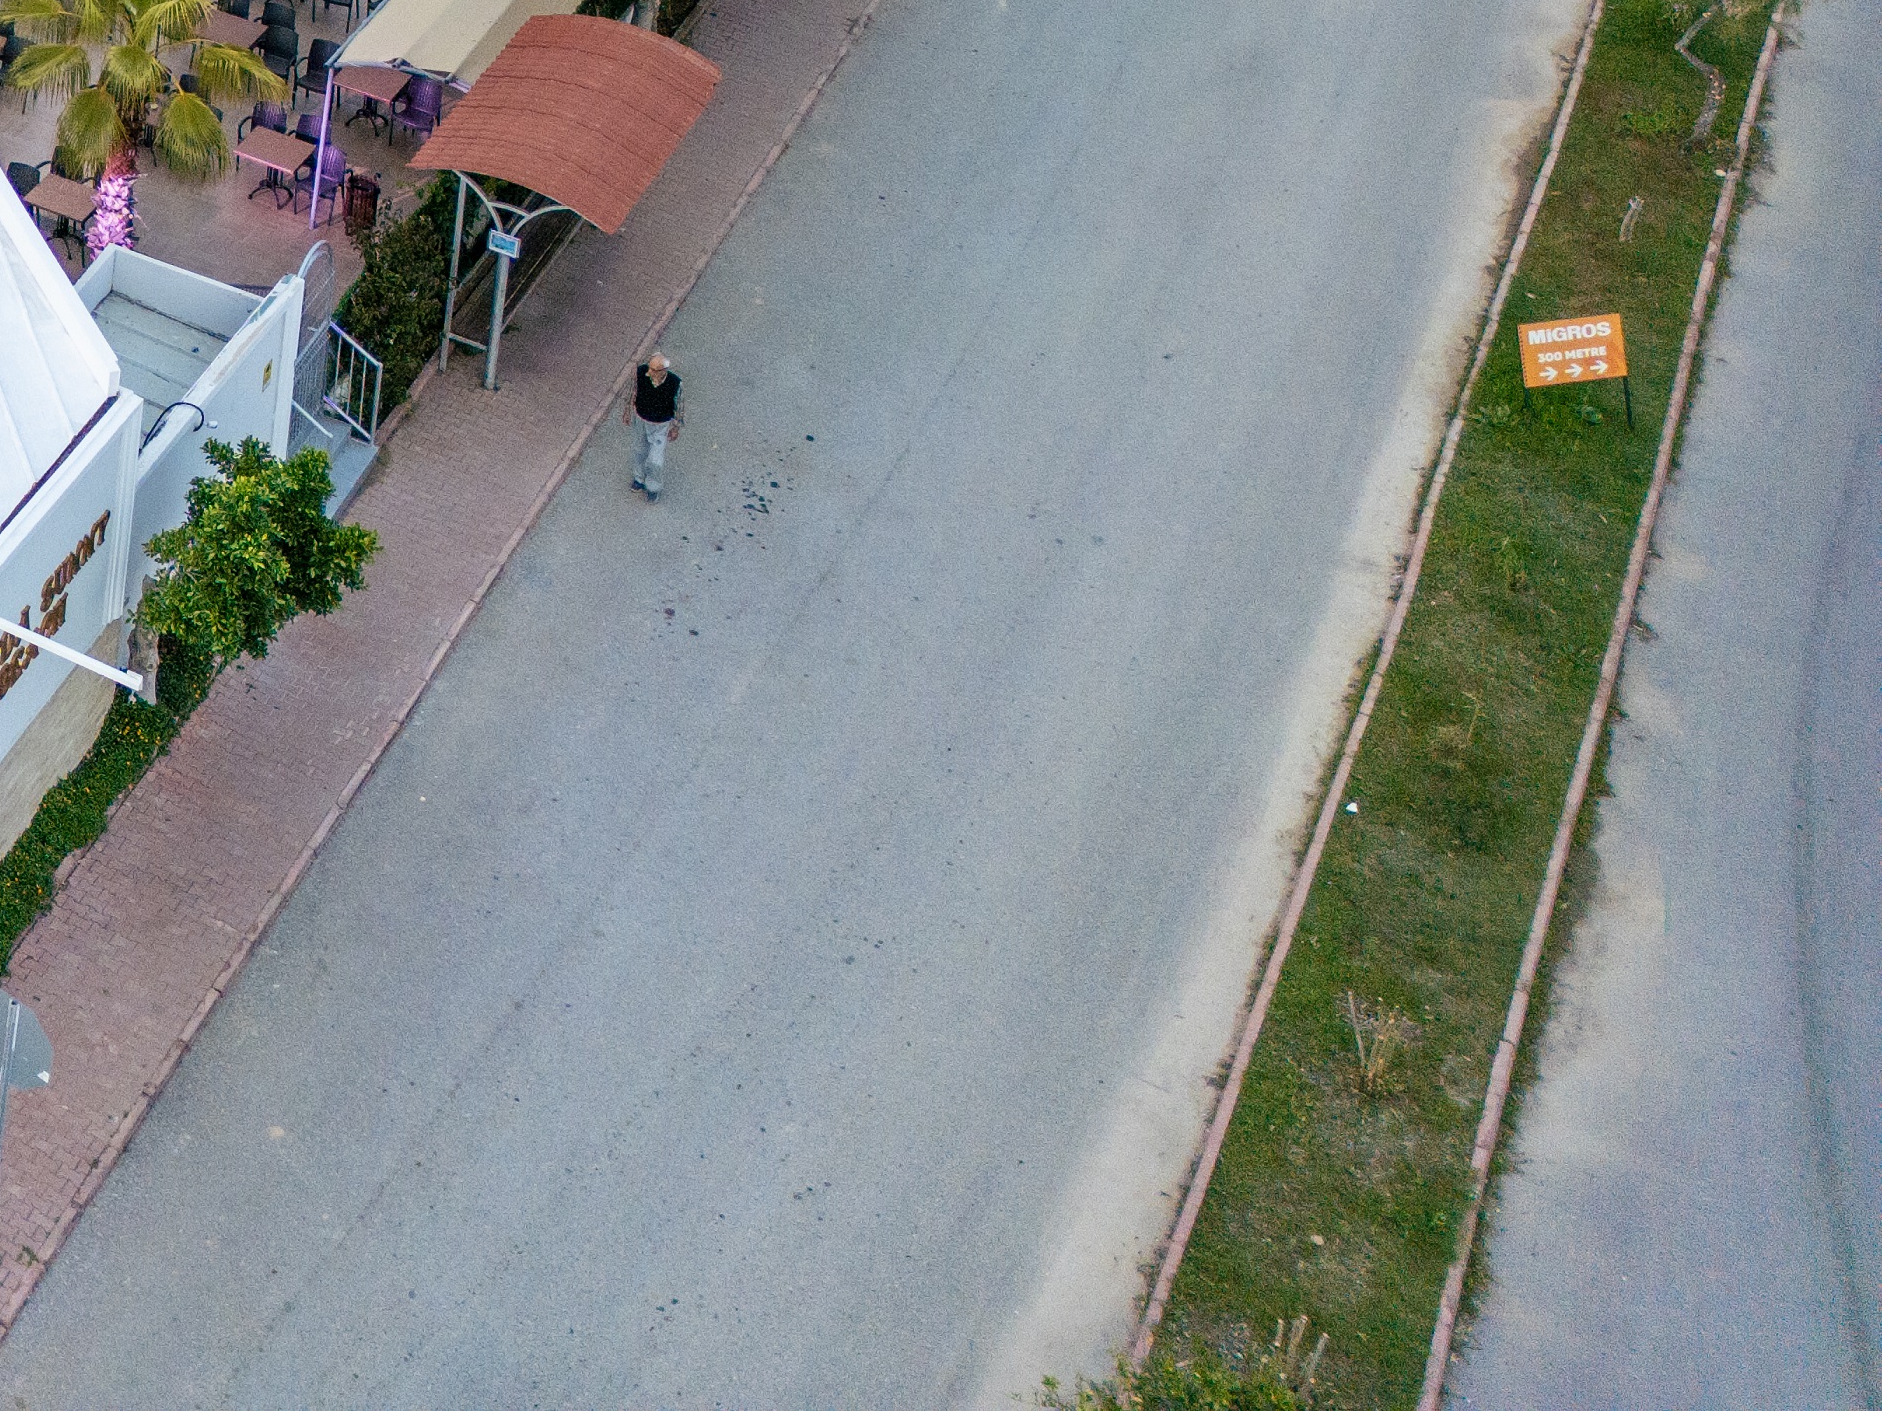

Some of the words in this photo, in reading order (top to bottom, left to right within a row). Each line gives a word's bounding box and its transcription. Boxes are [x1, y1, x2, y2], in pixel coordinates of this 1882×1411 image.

[1528, 321, 1612, 345] MIGROS
[1537, 351, 1563, 363] 300
[1564, 346, 1607, 360] METRE
